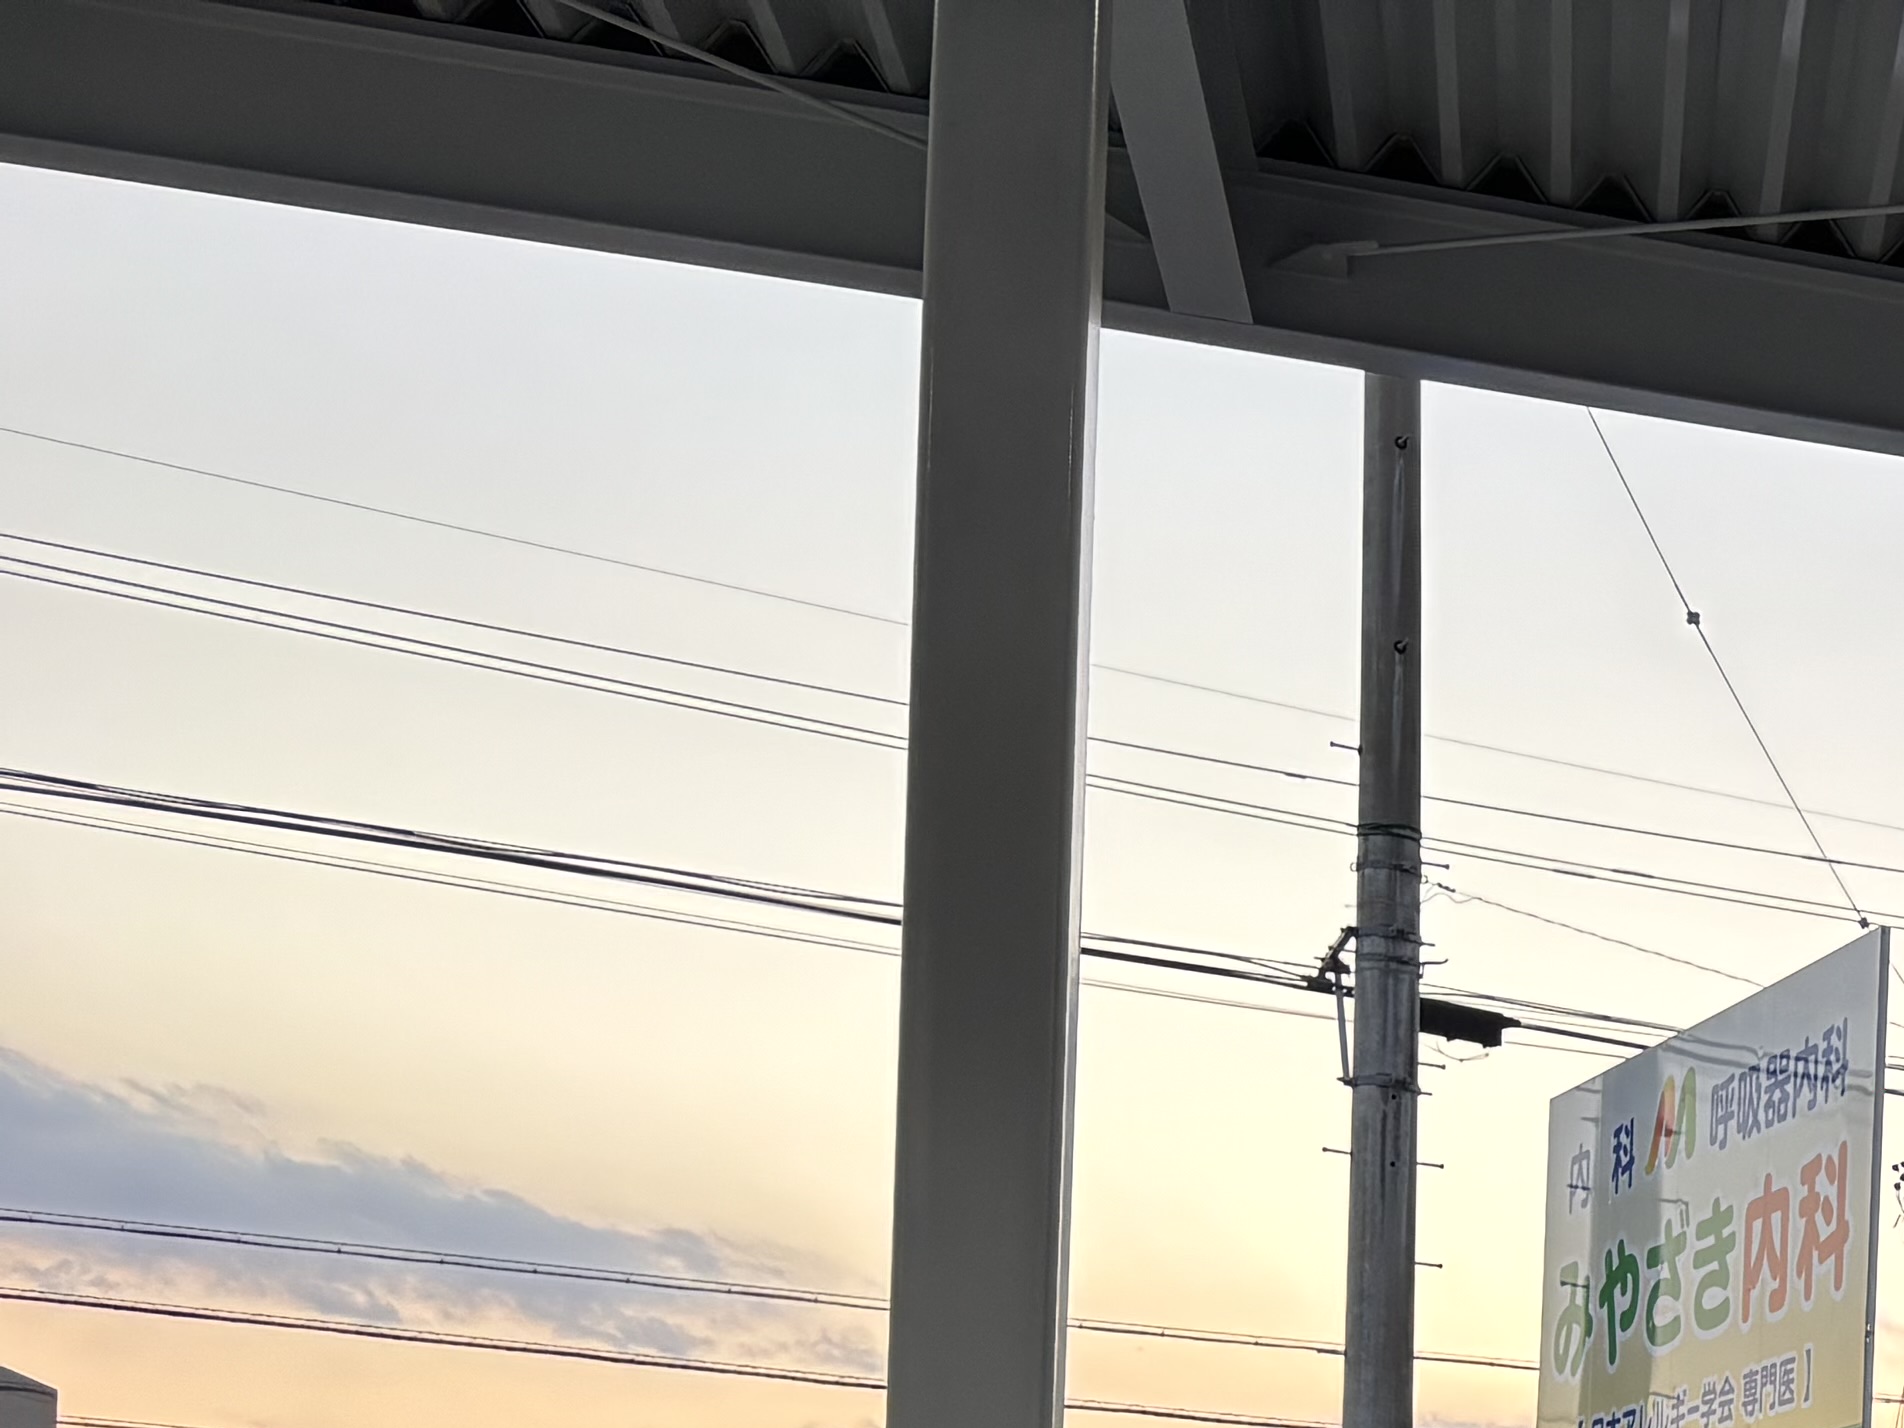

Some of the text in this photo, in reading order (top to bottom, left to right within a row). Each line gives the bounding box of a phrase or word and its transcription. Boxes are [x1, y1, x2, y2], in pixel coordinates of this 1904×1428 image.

[1709, 1017, 1849, 1151] 呼吸器内科
[1553, 1140, 1850, 1379] みやざき内科
